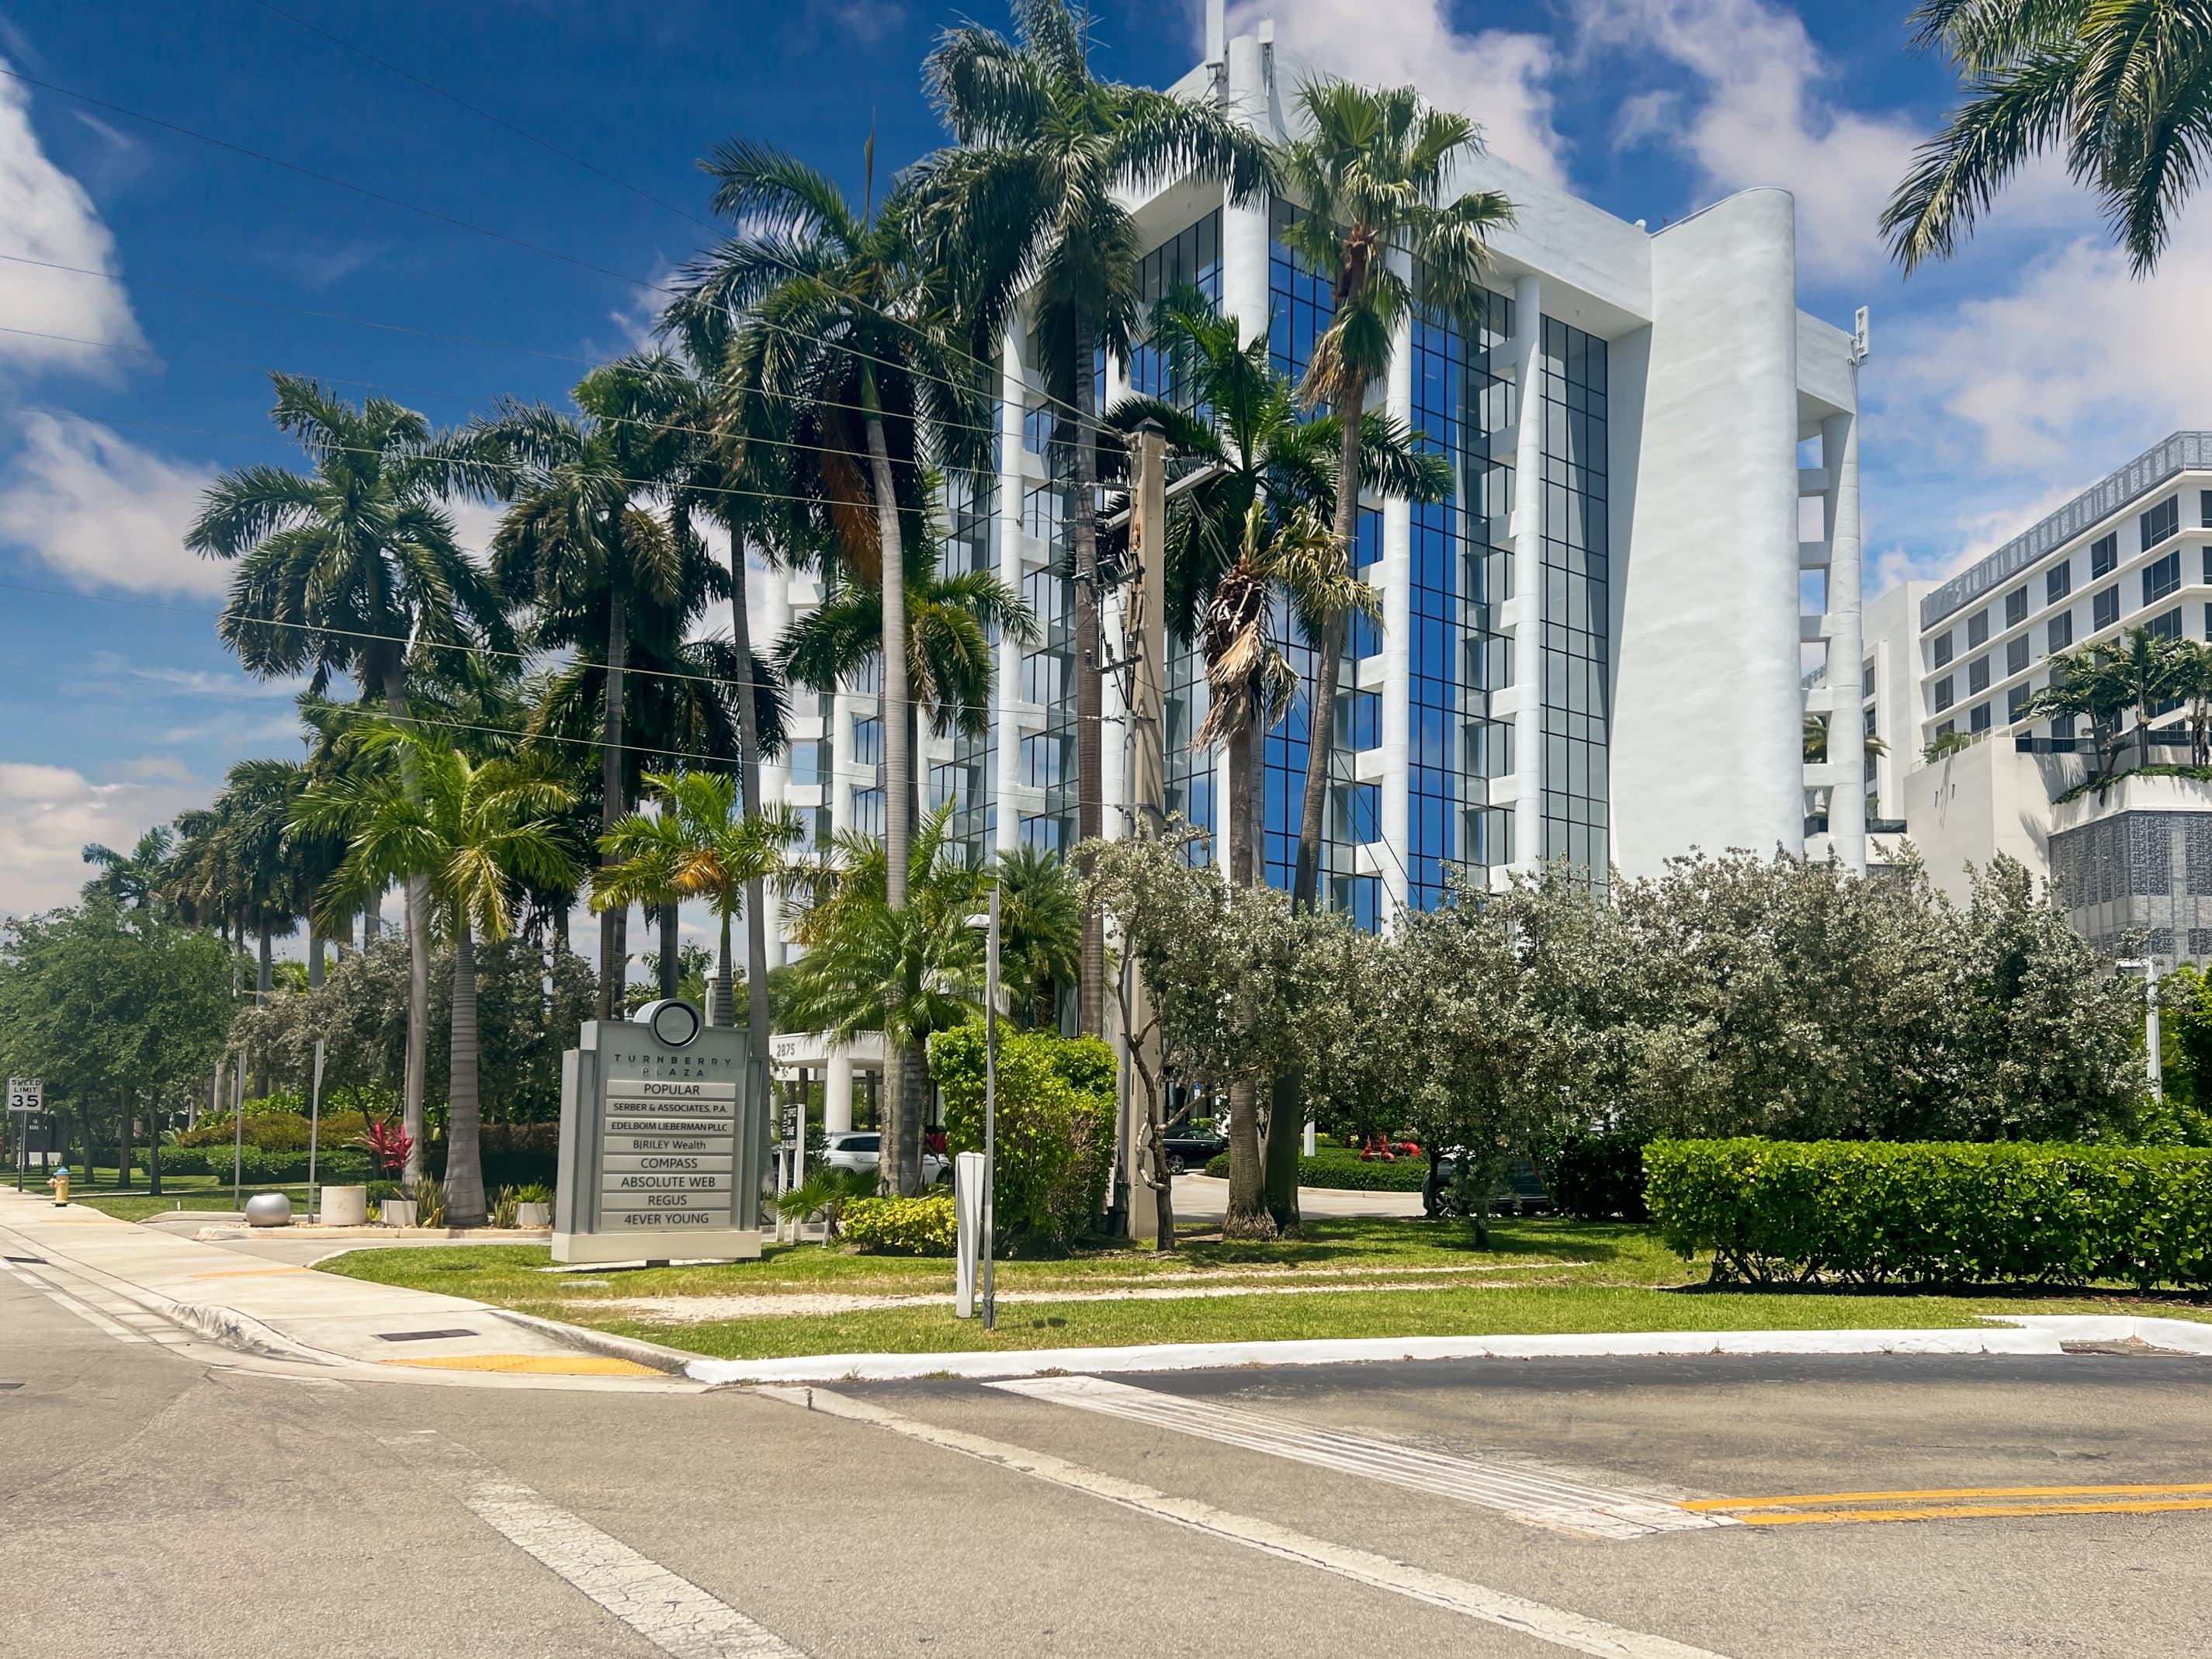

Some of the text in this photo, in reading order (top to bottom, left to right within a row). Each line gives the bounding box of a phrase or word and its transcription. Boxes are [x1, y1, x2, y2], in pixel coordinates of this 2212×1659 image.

[615, 1054, 731, 1066] TURNBERRY
[642, 1067, 704, 1077] PLAZA
[644, 1083, 700, 1096] POPULAR
[12, 1095, 39, 1107] 35
[613, 1103, 647, 1111] SERBER
[657, 1103, 712, 1113] ASSOCIATES,
[611, 1121, 657, 1130] EDELBOIM
[672, 1141, 706, 1149] Wealth
[640, 1158, 698, 1169] COMPASS
[621, 1176, 716, 1187] ABSOLUTE WEB
[647, 1195, 687, 1205] REGUS
[624, 1213, 709, 1224] 4EVER YOUNG
